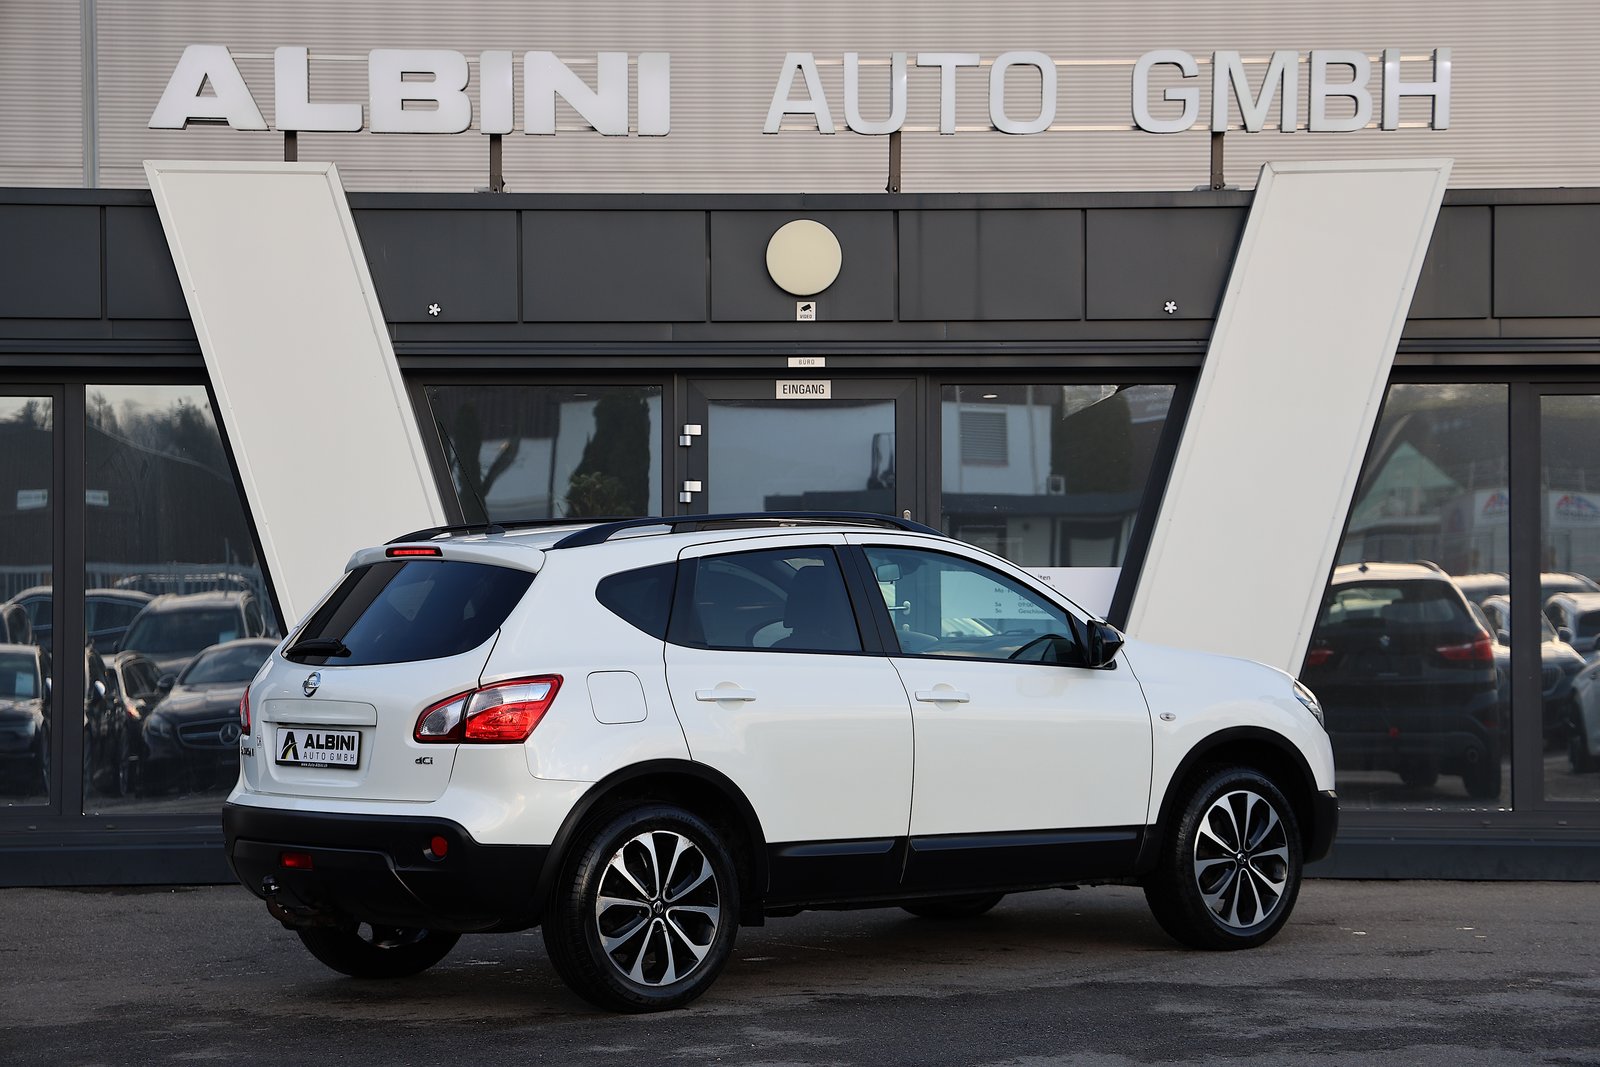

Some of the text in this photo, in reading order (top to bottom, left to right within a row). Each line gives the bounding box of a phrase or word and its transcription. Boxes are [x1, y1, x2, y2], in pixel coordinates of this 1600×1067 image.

[148, 44, 1452, 137] ALBINI AUTO GMBH
[783, 384, 825, 394] EINGANG
[304, 733, 356, 751] ALBINI
[303, 752, 355, 761] AUTO GMBH
[415, 756, 433, 764] dCi
